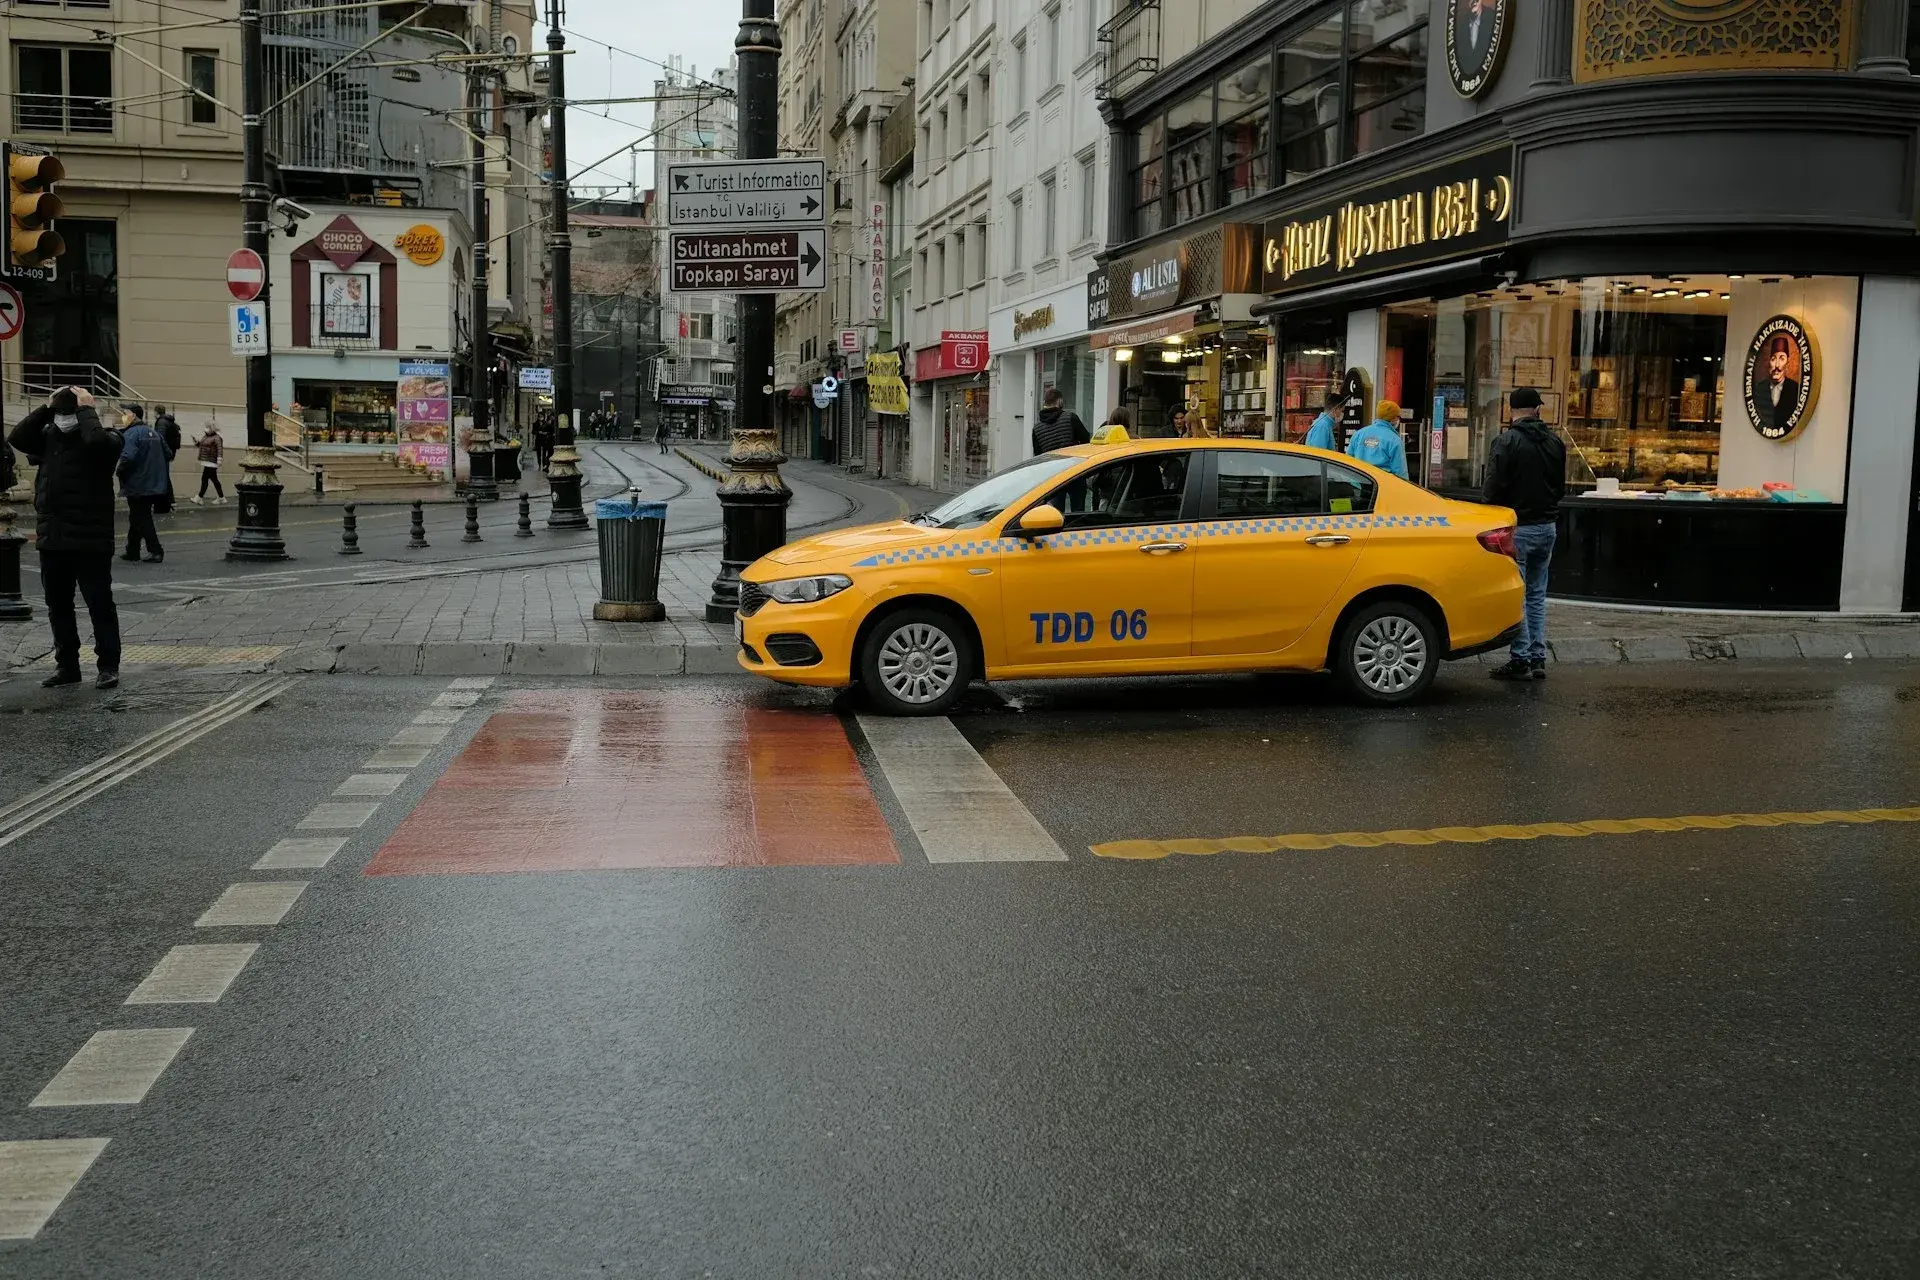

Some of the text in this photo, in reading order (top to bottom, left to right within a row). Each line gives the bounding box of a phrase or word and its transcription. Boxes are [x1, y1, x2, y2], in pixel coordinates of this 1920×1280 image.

[1462, 75, 1480, 91] 1864
[696, 171, 819, 190] Turist Information
[675, 201, 786, 219] İstanbul Valiliği
[1281, 178, 1480, 281] HAFIZ MUSTAFA 1864
[323, 233, 363, 243] CHOCO
[393, 232, 439, 248] BÖREK
[323, 242, 363, 251] CORNER
[407, 244, 437, 254] CORNER
[676, 238, 788, 258] Sultanahmet
[872, 204, 883, 318] PHARMACY
[12, 266, 44, 279] 12-409
[676, 264, 794, 287] Topkapı Sarayı
[1141, 259, 1156, 292] ALİ
[1158, 258, 1178, 287] USTA
[237, 333, 259, 343] EDS
[843, 332, 855, 347] E
[961, 357, 971, 365] 24
[1798, 335, 1811, 372] HAFIZ
[413, 358, 435, 366] TOST
[1786, 375, 1811, 427] MUSTAFA
[1747, 399, 1761, 427] HACI
[1762, 427, 1785, 437] 1864
[419, 445, 448, 454] FRESH
[420, 456, 448, 464] JUICE
[1029, 609, 1147, 644] TDD 06
